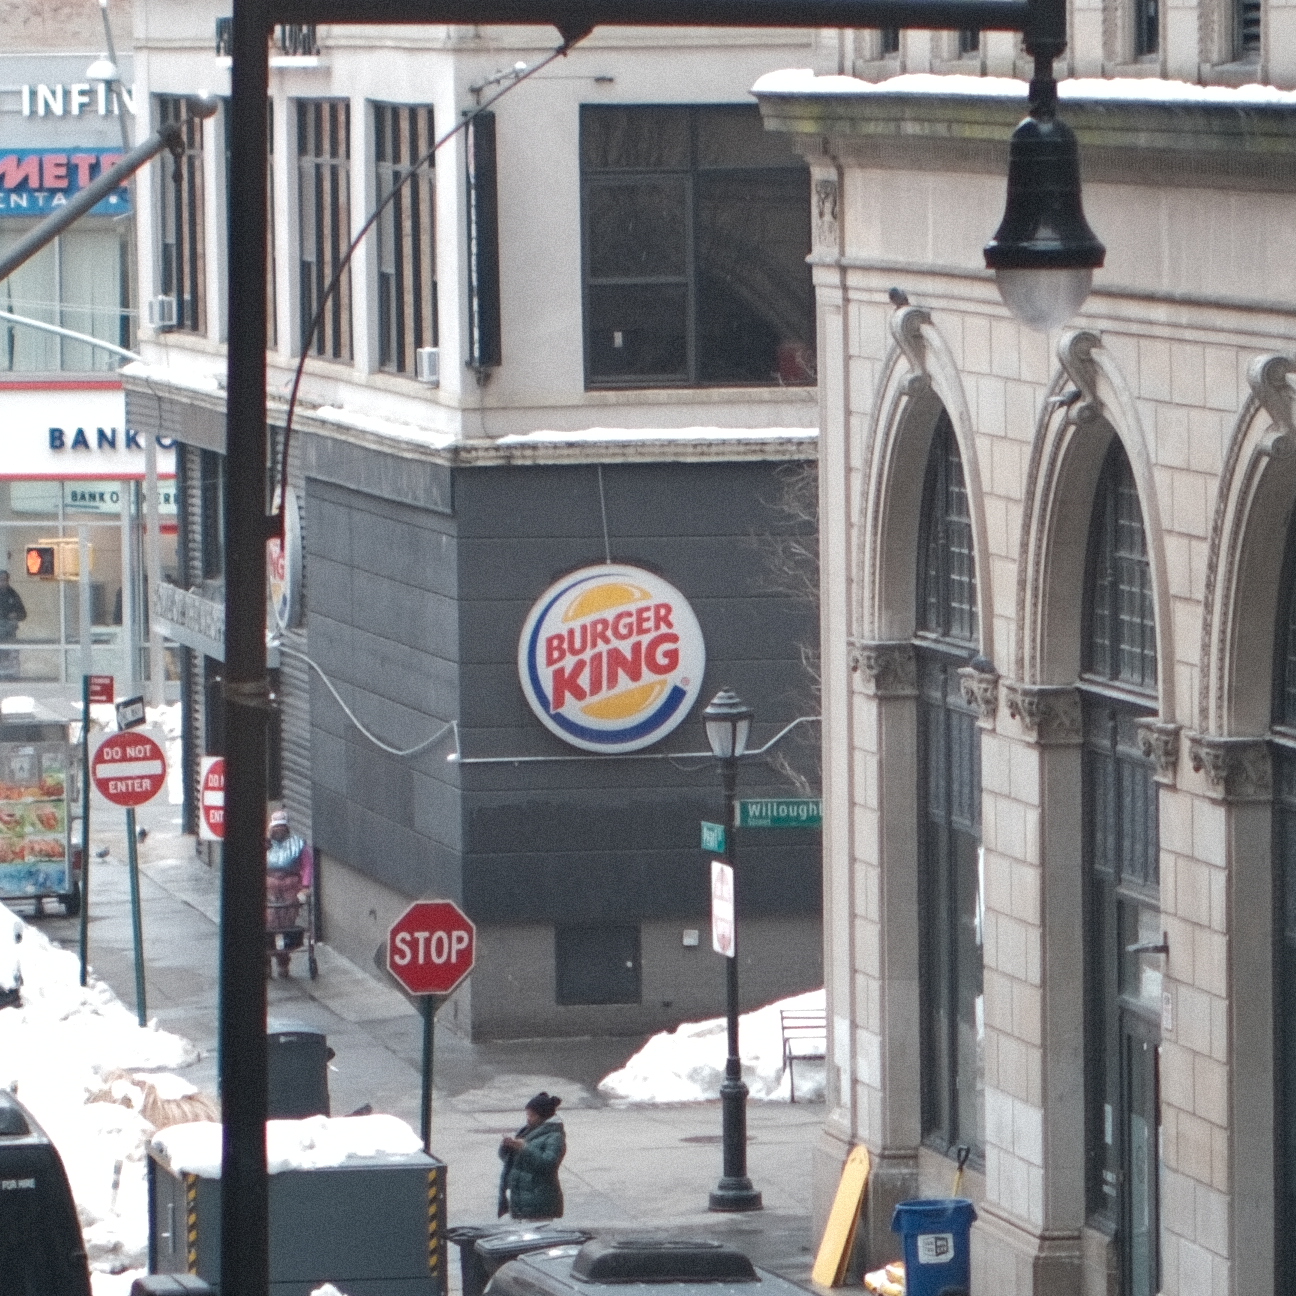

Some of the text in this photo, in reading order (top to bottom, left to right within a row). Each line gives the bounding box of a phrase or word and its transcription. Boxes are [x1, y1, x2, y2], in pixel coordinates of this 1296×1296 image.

[49, 427, 143, 449] BANK
[71, 490, 106, 503] BANK
[545, 602, 674, 668] BURGER
[551, 632, 680, 712] KING
[103, 745, 152, 760] DO NOT
[108, 779, 152, 794] ENTER
[208, 774, 219, 788] DO
[394, 930, 469, 966] STOP
